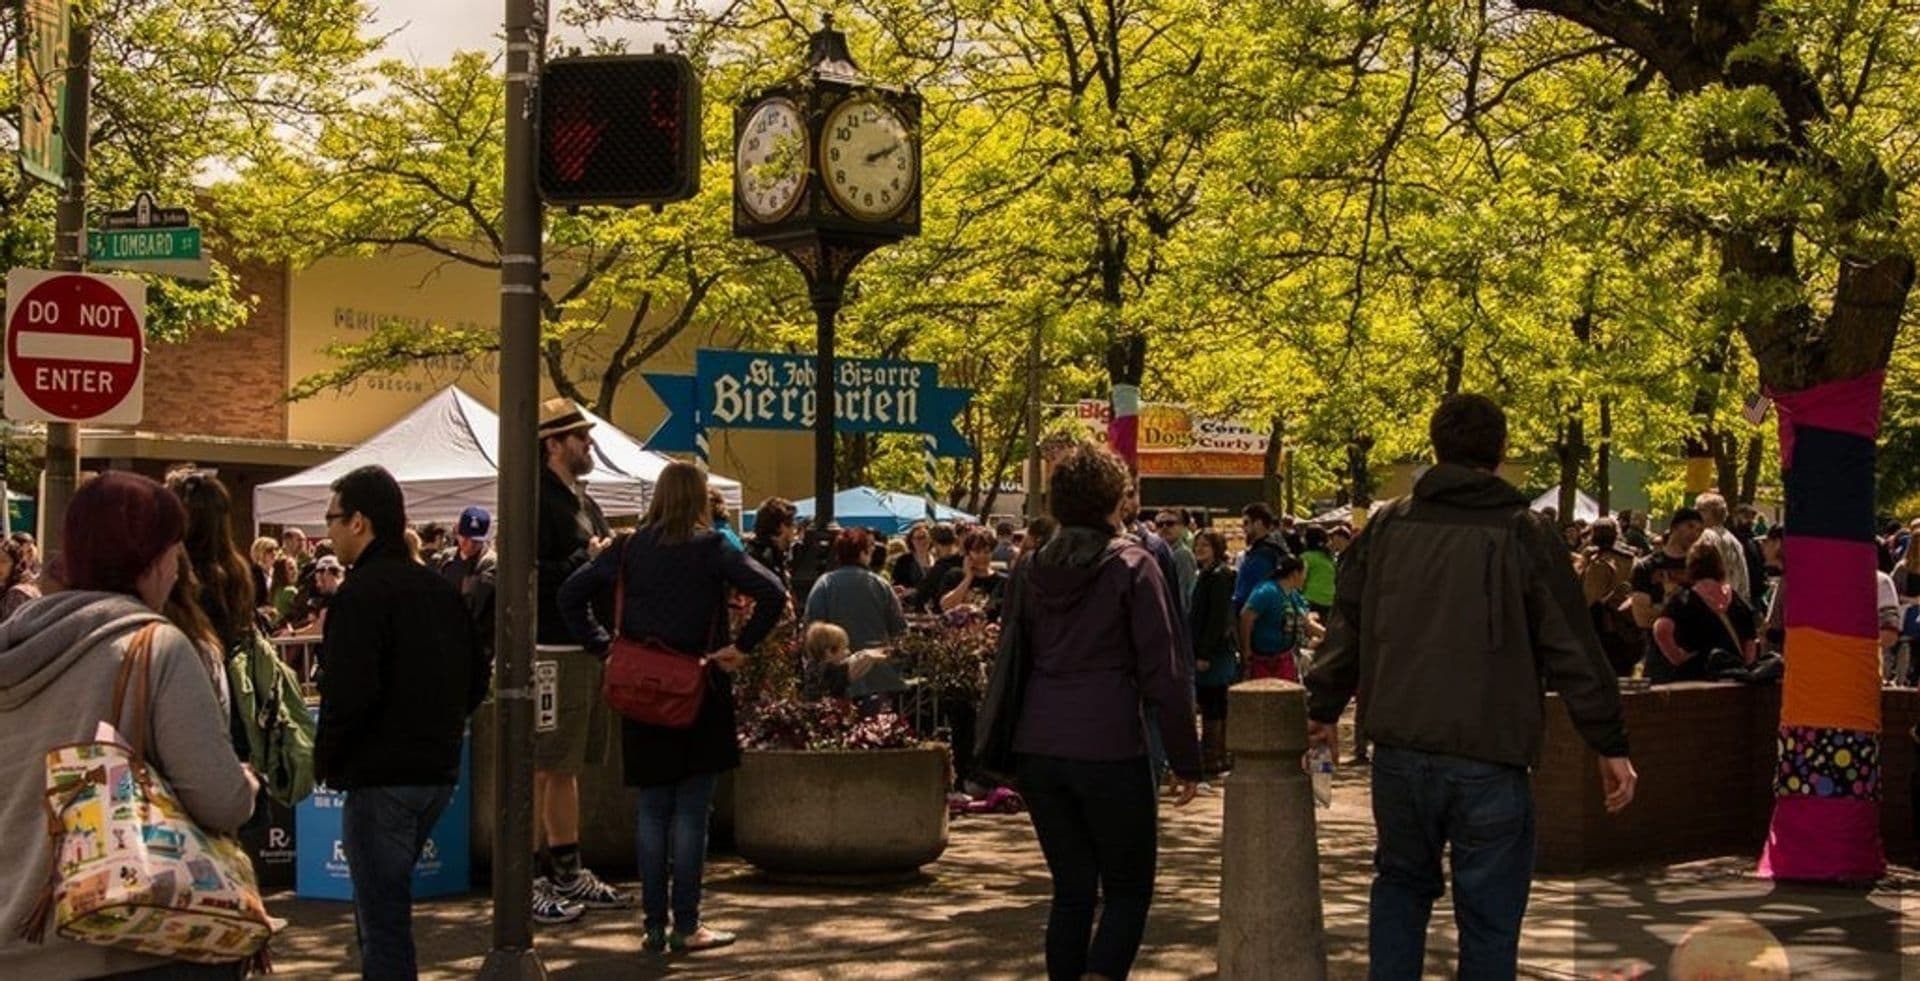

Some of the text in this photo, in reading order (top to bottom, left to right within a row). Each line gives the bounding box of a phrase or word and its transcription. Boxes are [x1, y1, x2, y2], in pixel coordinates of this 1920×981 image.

[848, 114, 859, 128] 11
[836, 127, 851, 141] 10
[830, 147, 840, 161] 9
[897, 156, 906, 170] 3
[835, 169, 846, 184] 8
[849, 185, 858, 199] 7
[881, 190, 891, 204] 5
[864, 192, 873, 207] 6
[112, 233, 174, 257] LOMBARD
[28, 300, 124, 329] DO NOT
[35, 367, 113, 394] ENTER
[744, 359, 780, 387] St.
[840, 361, 921, 389] Bizarre
[1080, 402, 1110, 424] Big
[1198, 437, 1253, 450] Curly
